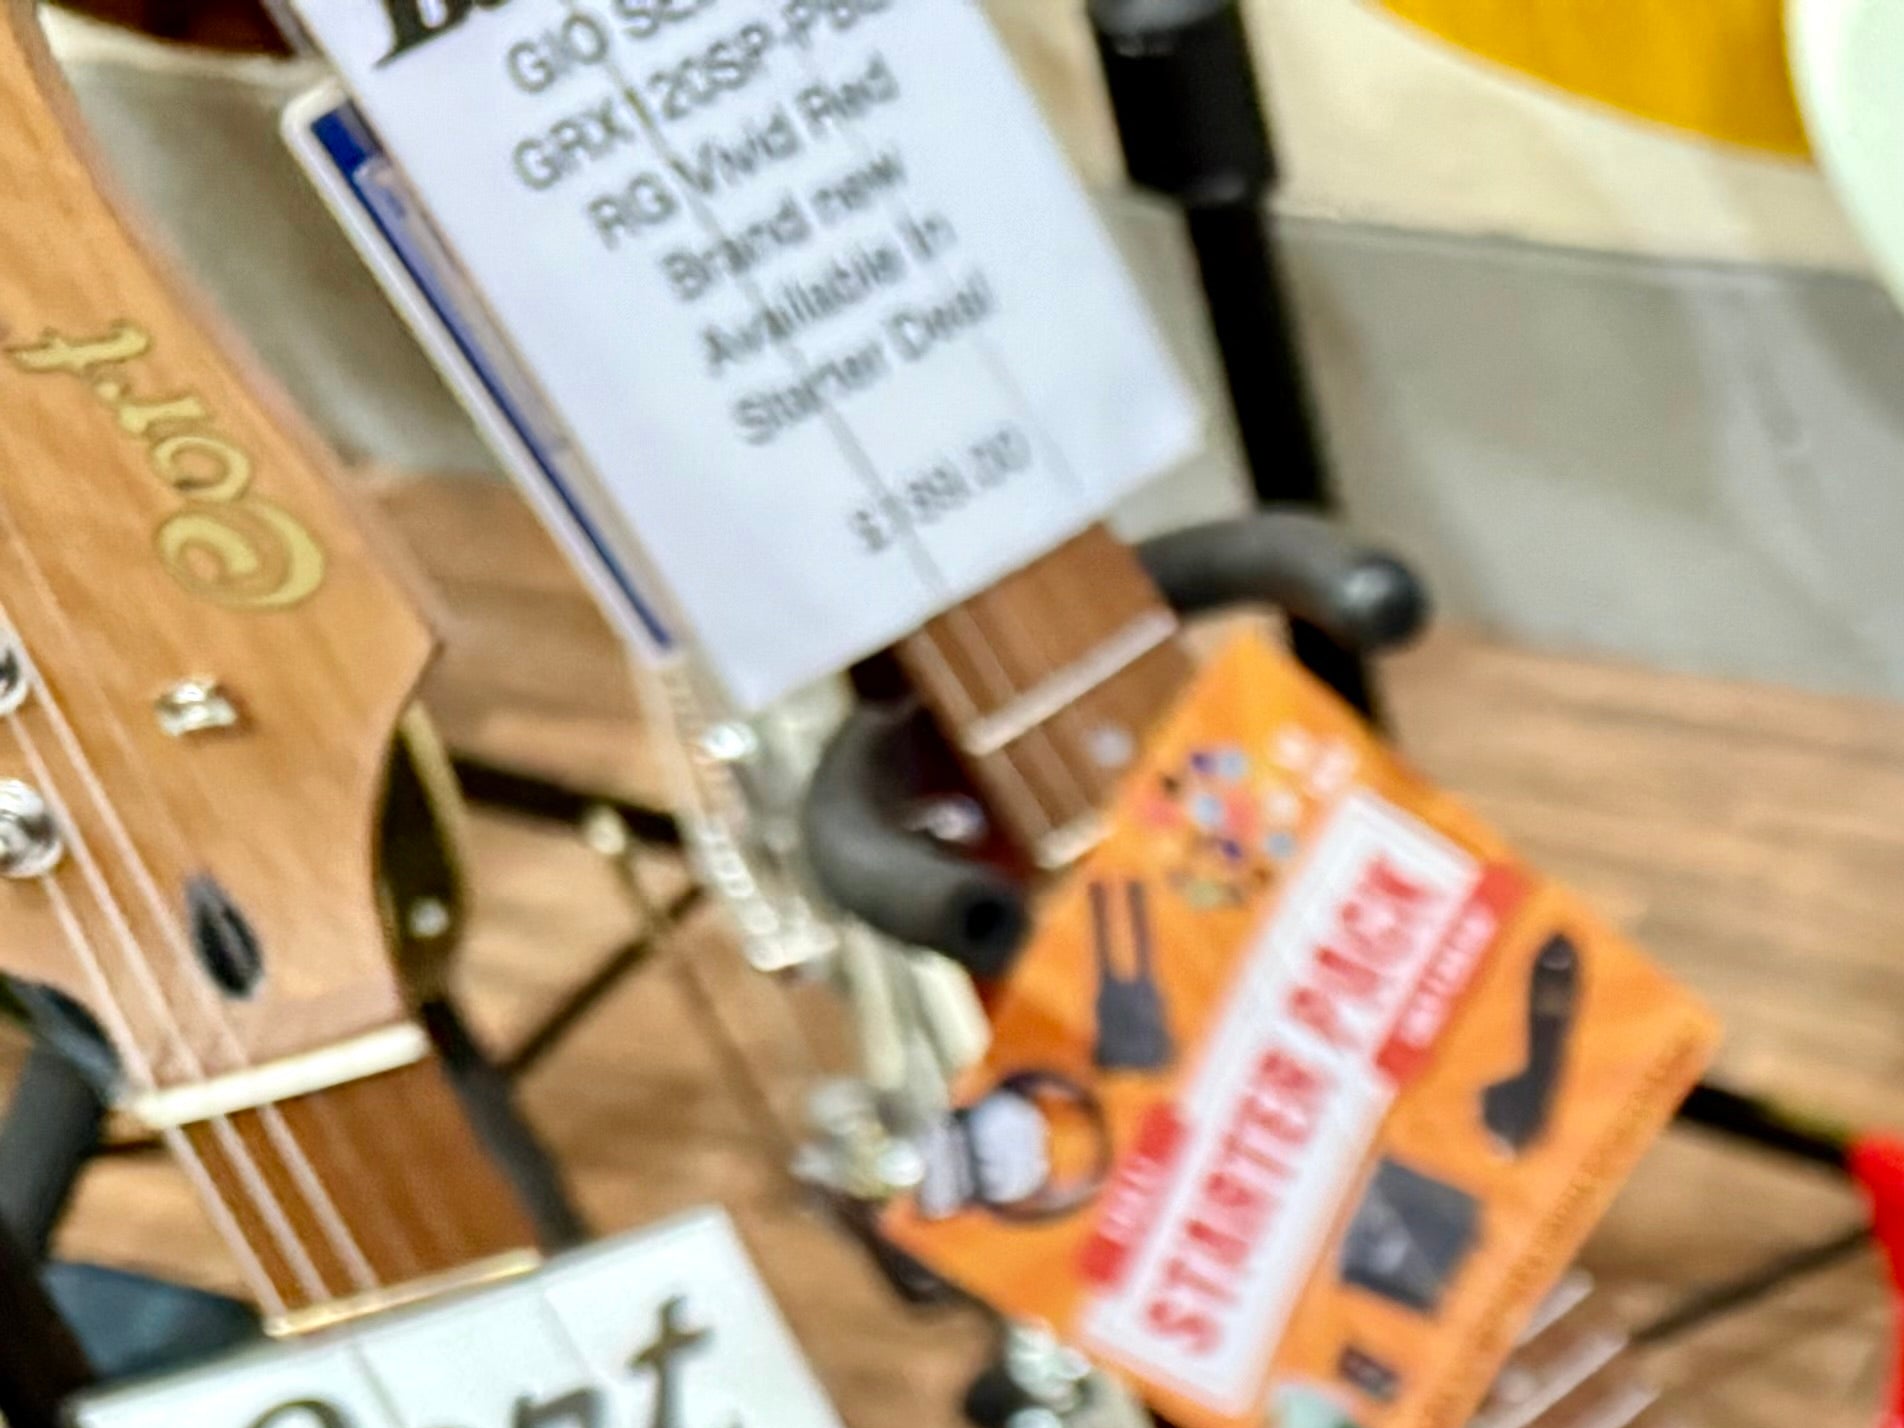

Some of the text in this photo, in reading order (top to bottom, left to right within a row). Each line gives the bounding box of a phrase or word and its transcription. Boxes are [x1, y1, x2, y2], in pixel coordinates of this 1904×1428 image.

[509, 13, 607, 92] GIO
[587, 53, 901, 249] RG Vivid Red
[661, 151, 907, 300] Brand new
[701, 242, 907, 372] Available
[732, 272, 992, 446] Starter Deal
[1143, 1052, 1325, 1355] STARTER
[1289, 853, 1424, 1054] PACK
